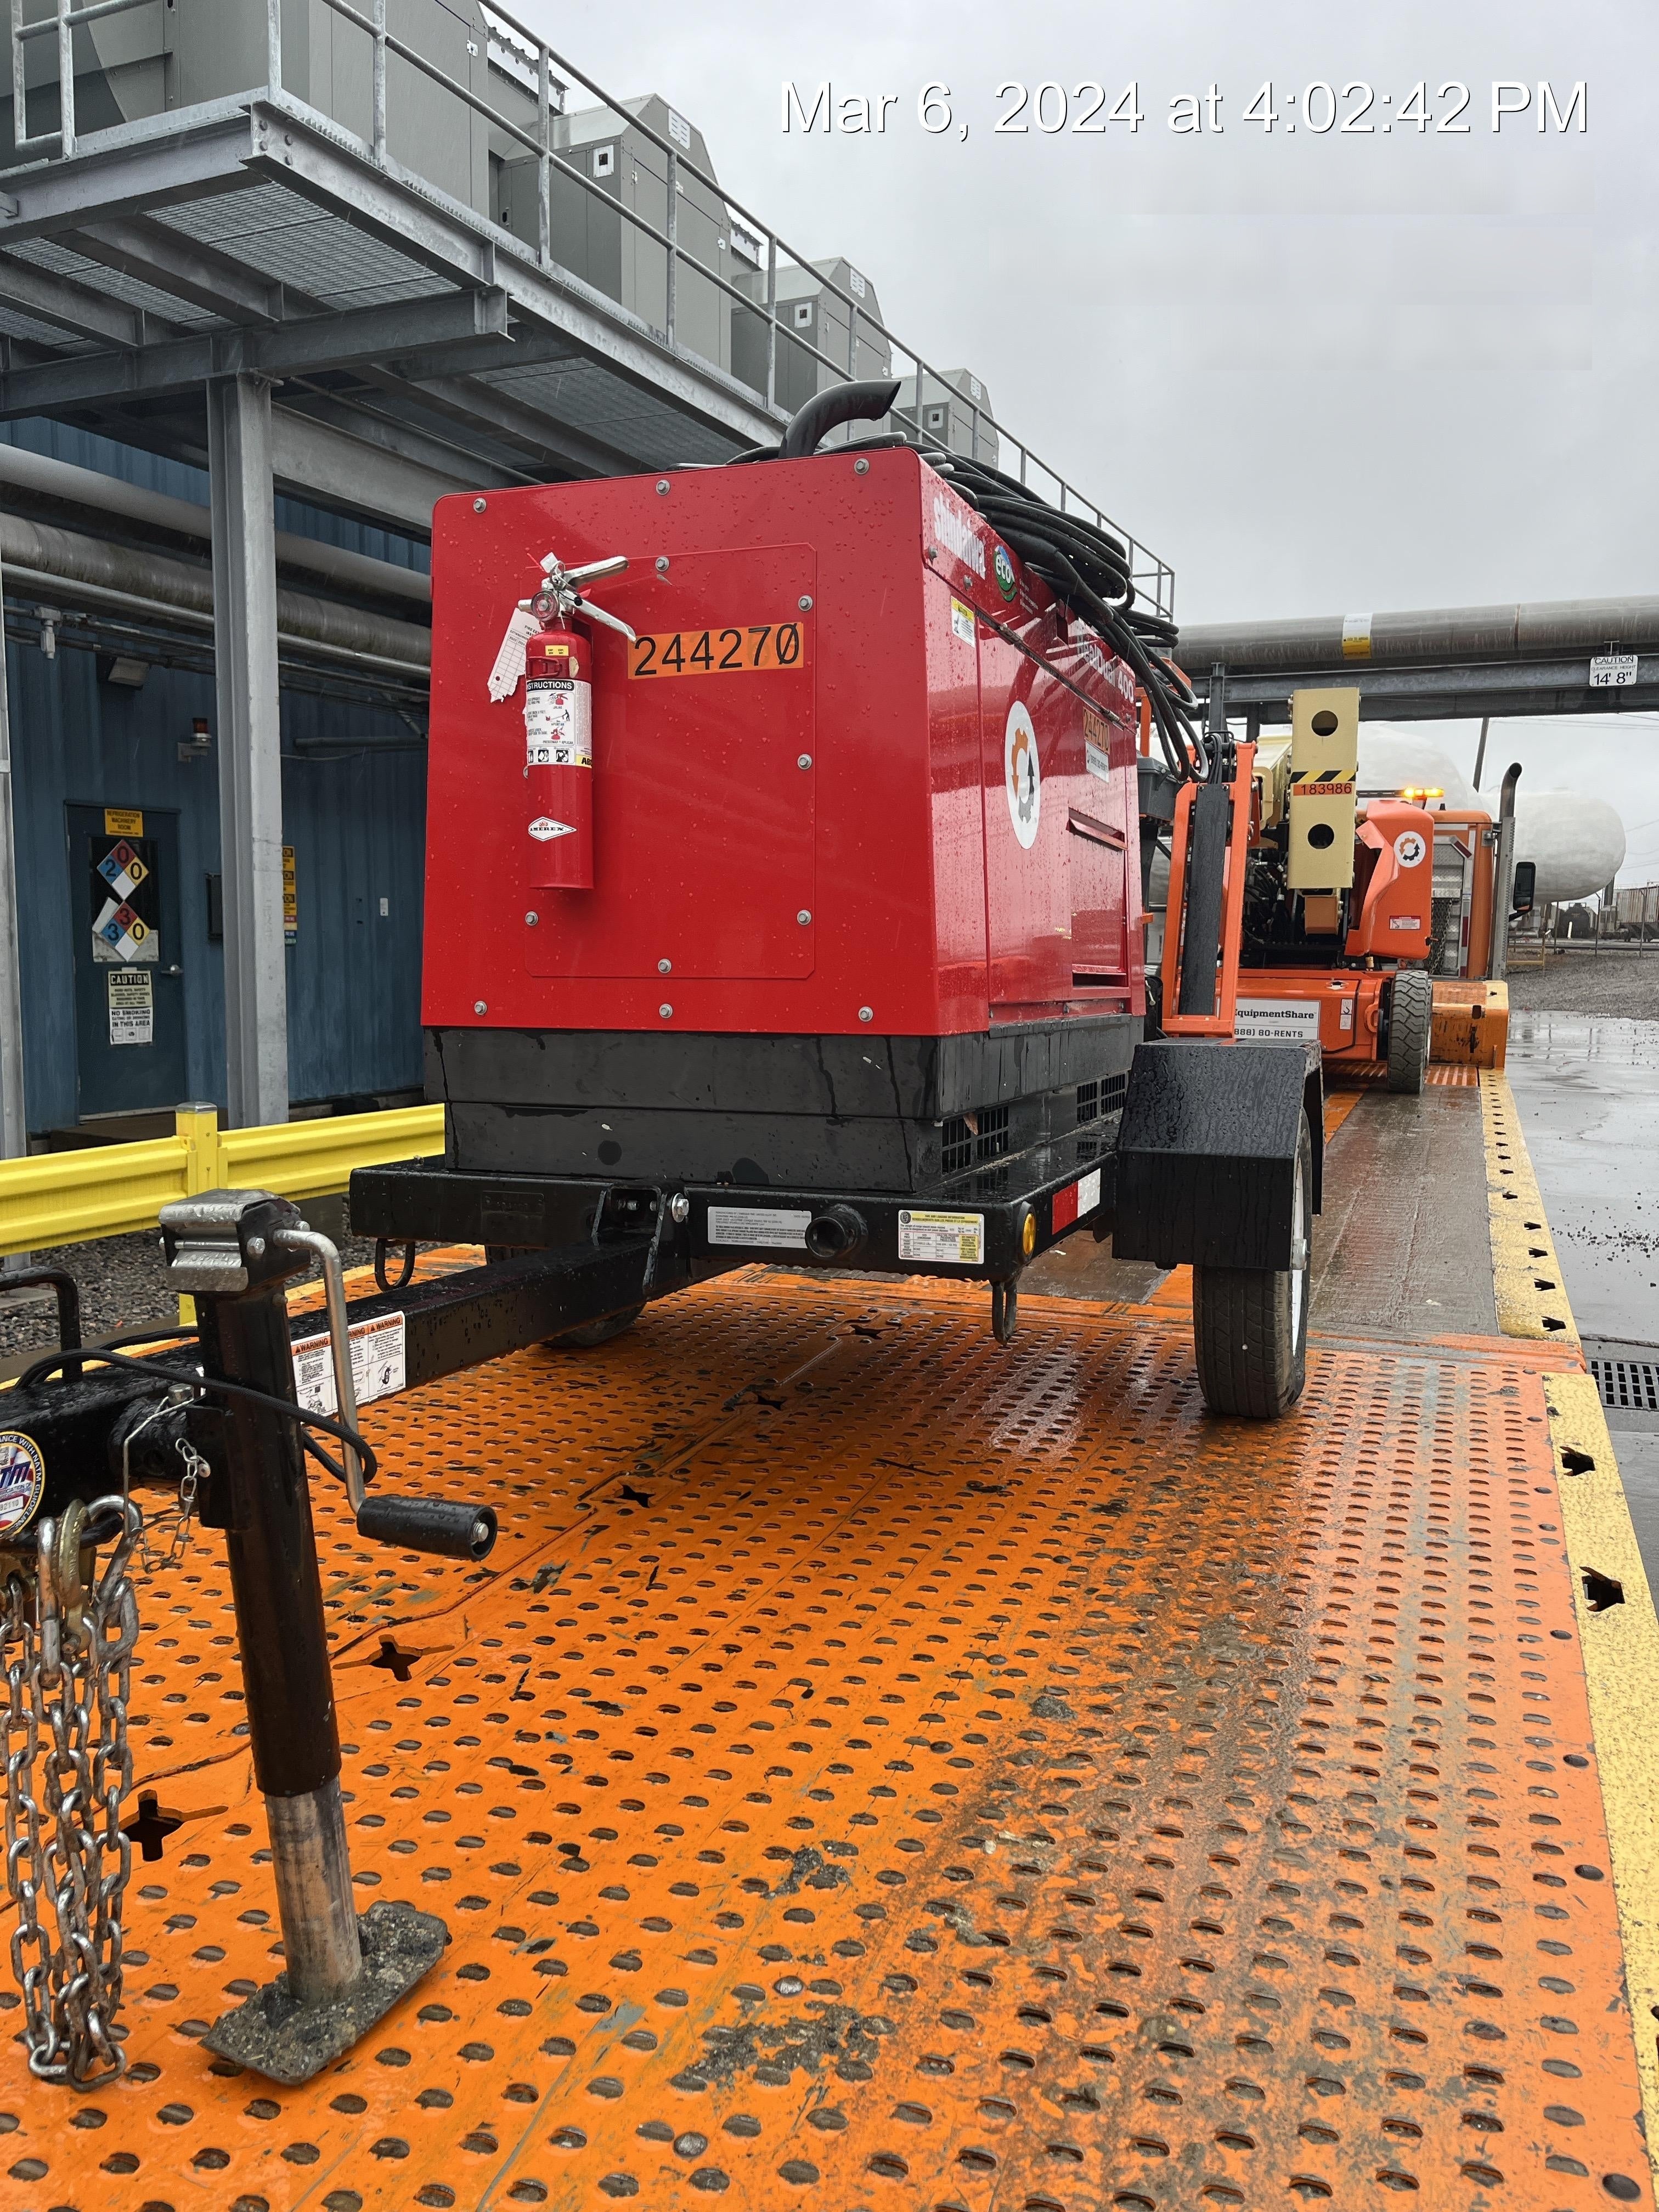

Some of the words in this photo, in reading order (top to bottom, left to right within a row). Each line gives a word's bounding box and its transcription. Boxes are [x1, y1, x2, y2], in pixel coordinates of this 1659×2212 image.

[933, 492, 986, 580] shindaiwa
[995, 554, 1011, 584] eco
[634, 623, 800, 676] 244270
[1594, 655, 1633, 664] CAUTION
[527, 681, 573, 690] STRUCTIONS
[1118, 670, 1134, 704] 400
[1594, 673, 1611, 686] 14'
[1616, 672, 1632, 685] 8"
[1084, 708, 1109, 752] 244270
[582, 757, 592, 766] AB
[1301, 783, 1352, 795] 183986
[117, 846, 129, 864] 0
[105, 859, 116, 877] 2
[130, 862, 142, 880] 0
[120, 908, 131, 926] 3
[108, 923, 119, 941] 3
[132, 923, 144, 940] 0
[111, 974, 149, 985] CAUTION
[1259, 1029, 1303, 1038] 80-RENTS
[376, 1317, 400, 1330] WARNING
[348, 1327, 365, 1339] RNING
[300, 1338, 328, 1352] WARNING
[19, 1437, 36, 1455] WITH
[33, 1454, 42, 1482] NATM
[0, 1462, 31, 1489] TM
